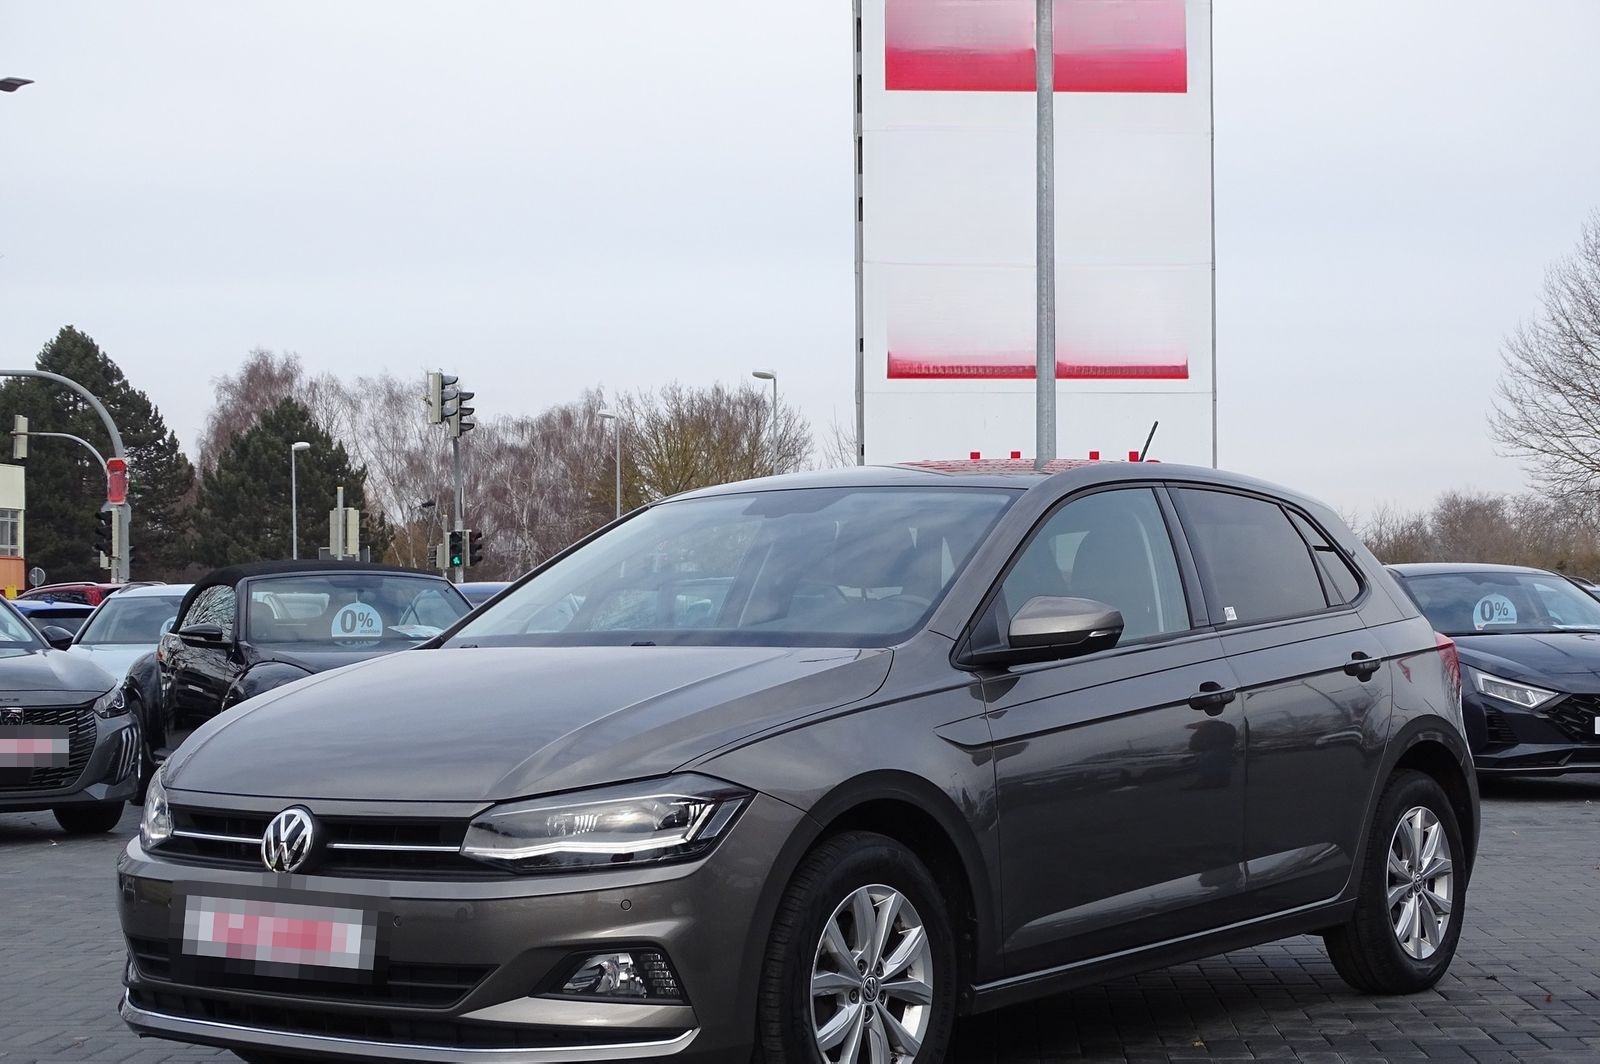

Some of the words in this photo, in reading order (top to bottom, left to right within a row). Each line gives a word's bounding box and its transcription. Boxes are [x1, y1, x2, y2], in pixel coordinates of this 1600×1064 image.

[341, 609, 374, 633] 0%
[1481, 600, 1509, 621] 0%
[263, 809, 312, 872] VW
